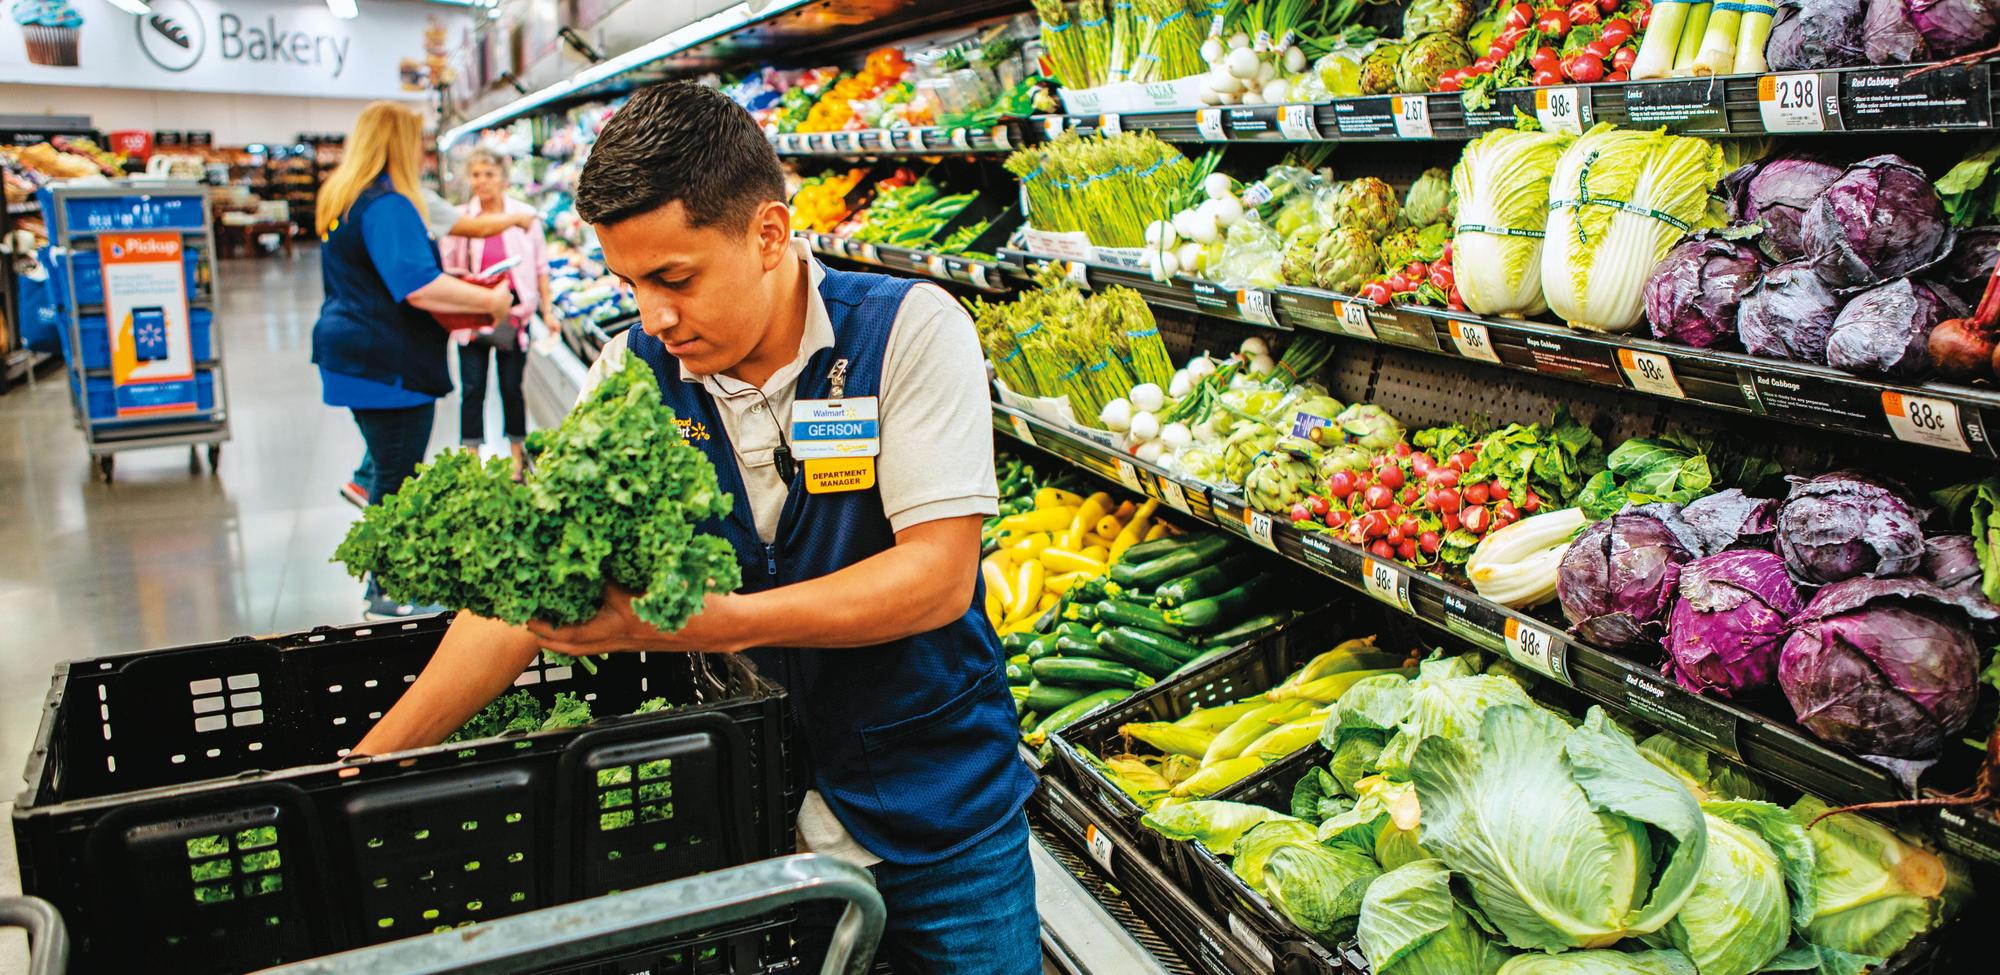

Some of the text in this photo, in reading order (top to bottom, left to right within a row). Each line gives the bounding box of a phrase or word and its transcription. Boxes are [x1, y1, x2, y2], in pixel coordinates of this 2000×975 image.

[220, 13, 350, 78] Bakery
[1852, 76, 1899, 88] Red Cabbage
[1776, 80, 1814, 109] $2.98
[1404, 101, 1423, 121] 2.87
[1826, 95, 1838, 115] USA
[125, 238, 180, 256] Pickup
[1463, 326, 1483, 348] 98¢
[1637, 358, 1665, 381] 98¢
[1757, 375, 1800, 392] Red Cabbage
[813, 409, 845, 418] Walmart
[1910, 401, 1945, 432] 88¢
[808, 423, 862, 437] GERSON
[1967, 424, 1983, 442] USA
[812, 469, 867, 480] DEPARTMENT
[820, 477, 861, 488] MANAGER
[1375, 567, 1391, 591] 98¢
[1520, 628, 1541, 657] 98¢
[1626, 674, 1665, 698] Red Cabbage
